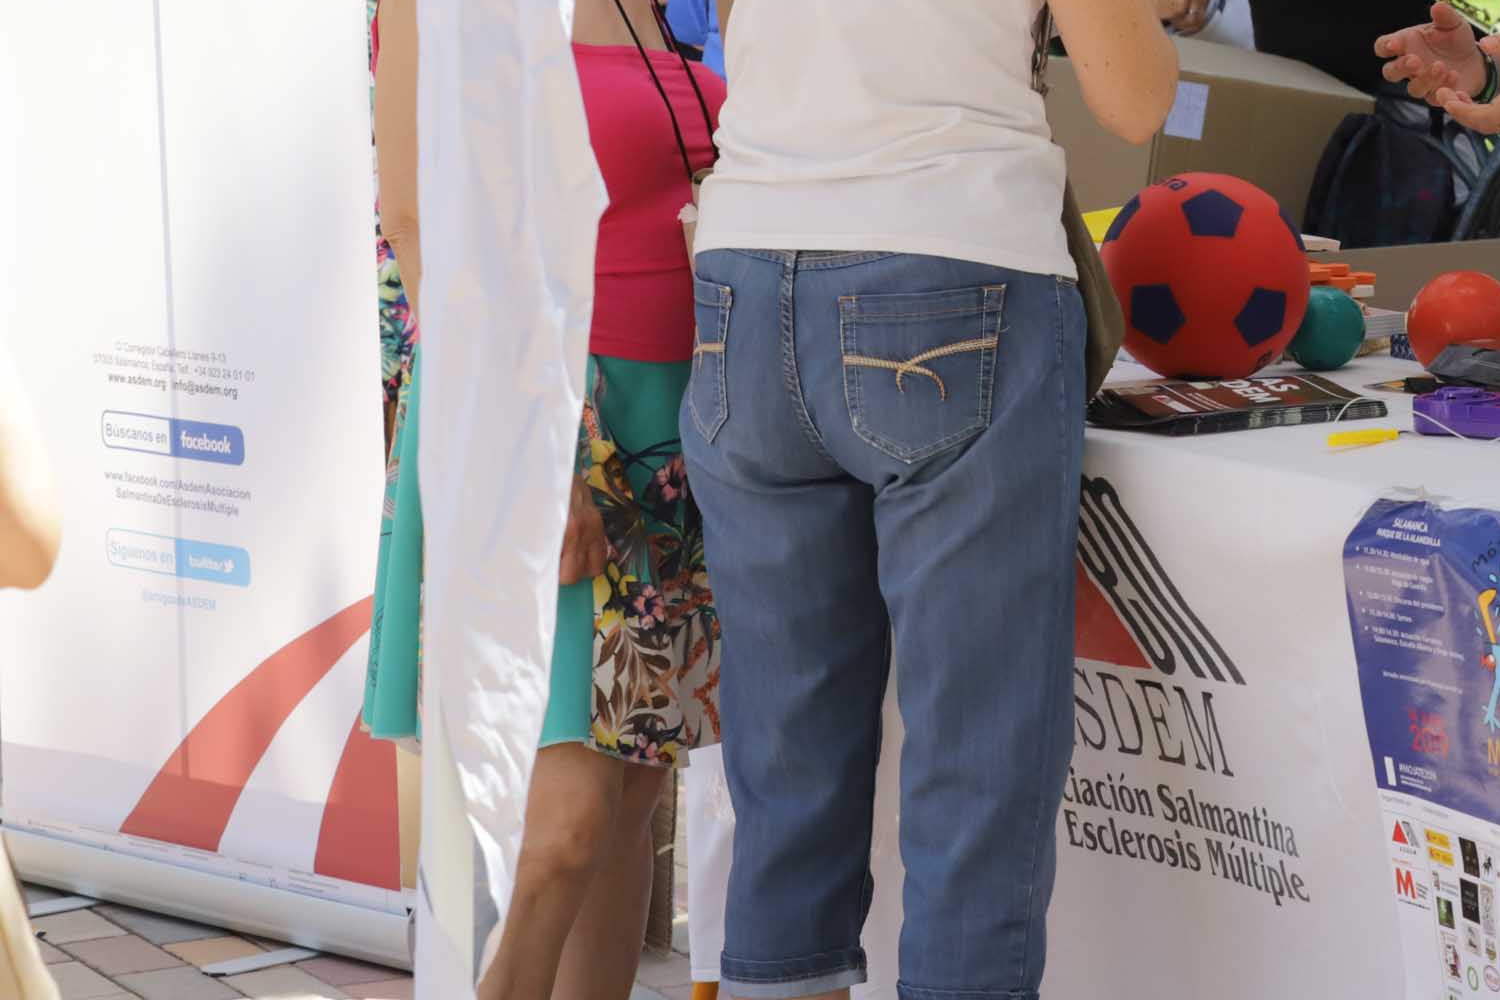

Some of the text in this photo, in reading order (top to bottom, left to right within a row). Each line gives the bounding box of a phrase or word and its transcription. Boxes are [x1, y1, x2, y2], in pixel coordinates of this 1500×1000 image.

[156, 433, 167, 445] en
[179, 429, 231, 455] facebook
[160, 550, 174, 566] en
[1074, 667, 1235, 778] SDEM
[1063, 809, 1312, 907] Esclerosis Múltiple
[1157, 782, 1300, 858] Salmantina
